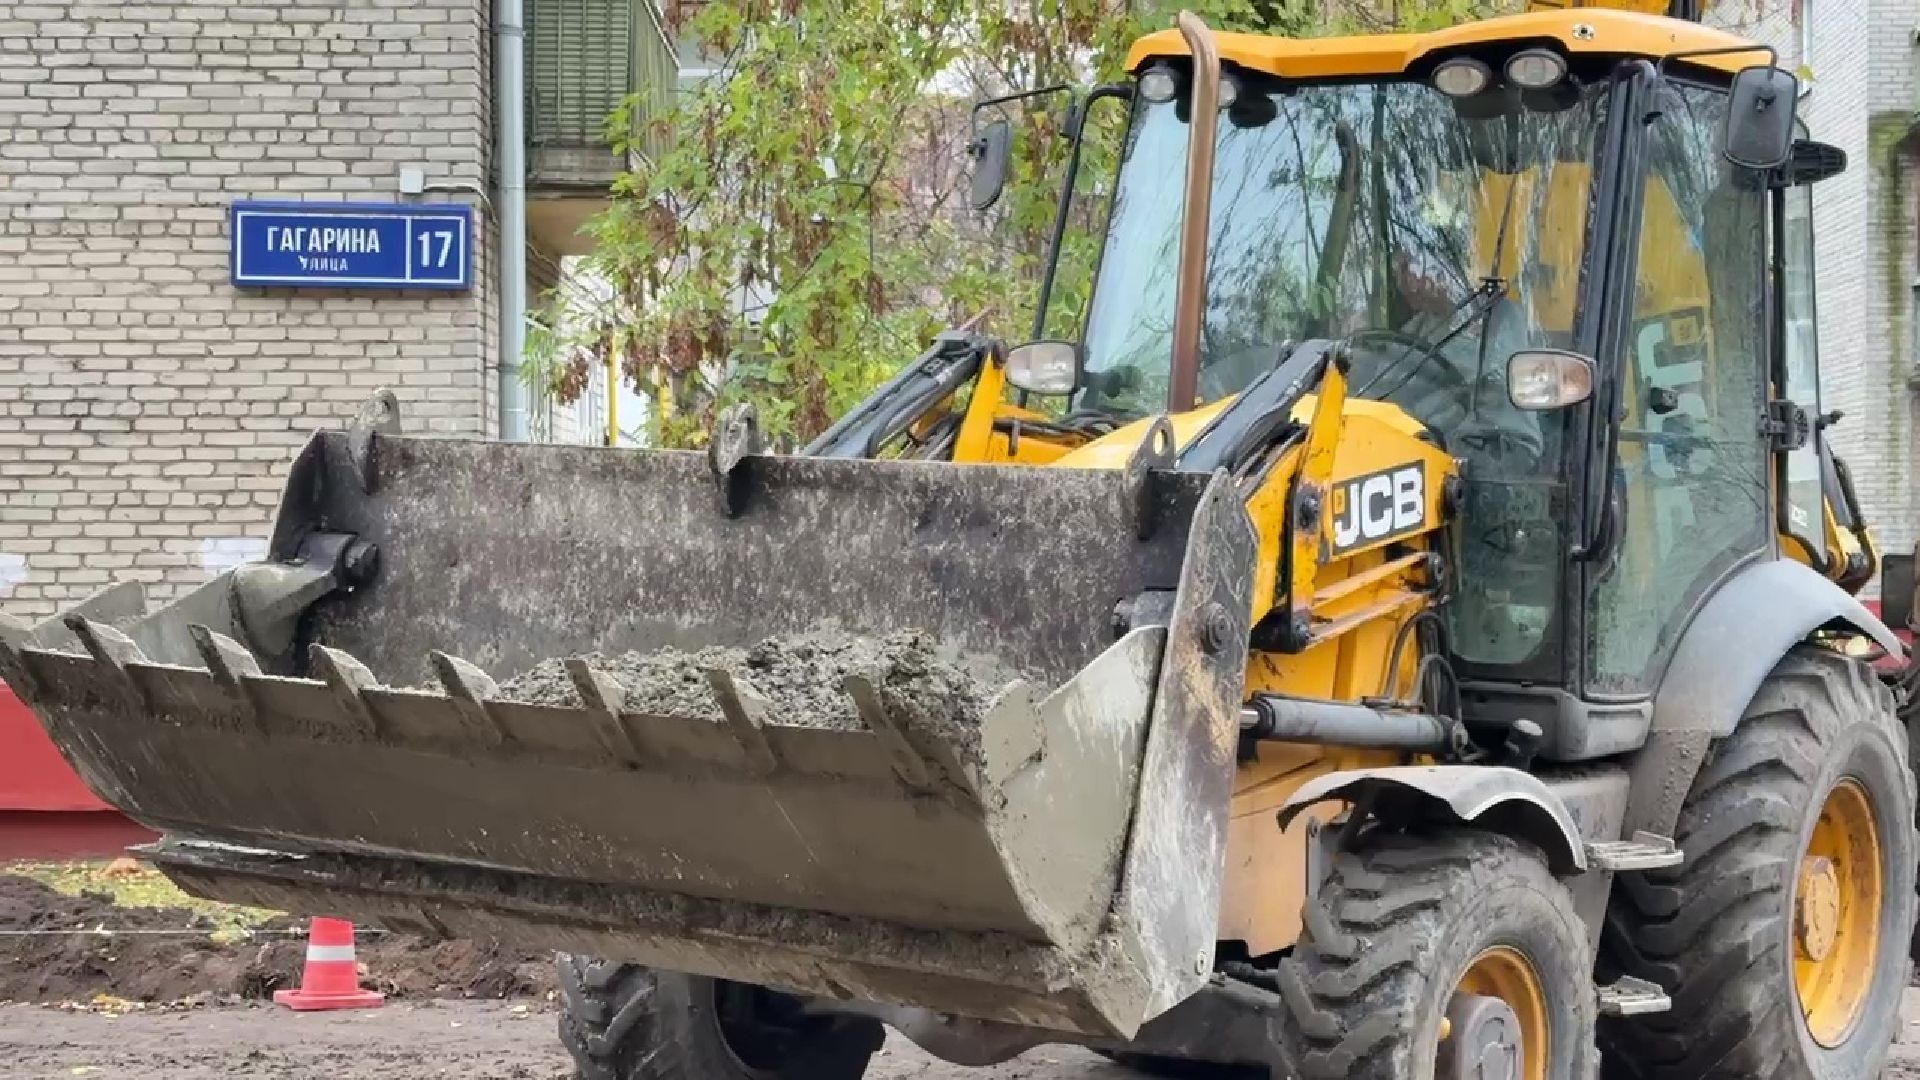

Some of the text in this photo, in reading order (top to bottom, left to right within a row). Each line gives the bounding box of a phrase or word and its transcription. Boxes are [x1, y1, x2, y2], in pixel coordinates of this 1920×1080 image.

[267, 226, 380, 253] ГАГАРИНА
[417, 231, 453, 268] 17
[1334, 467, 1423, 547] JCB
